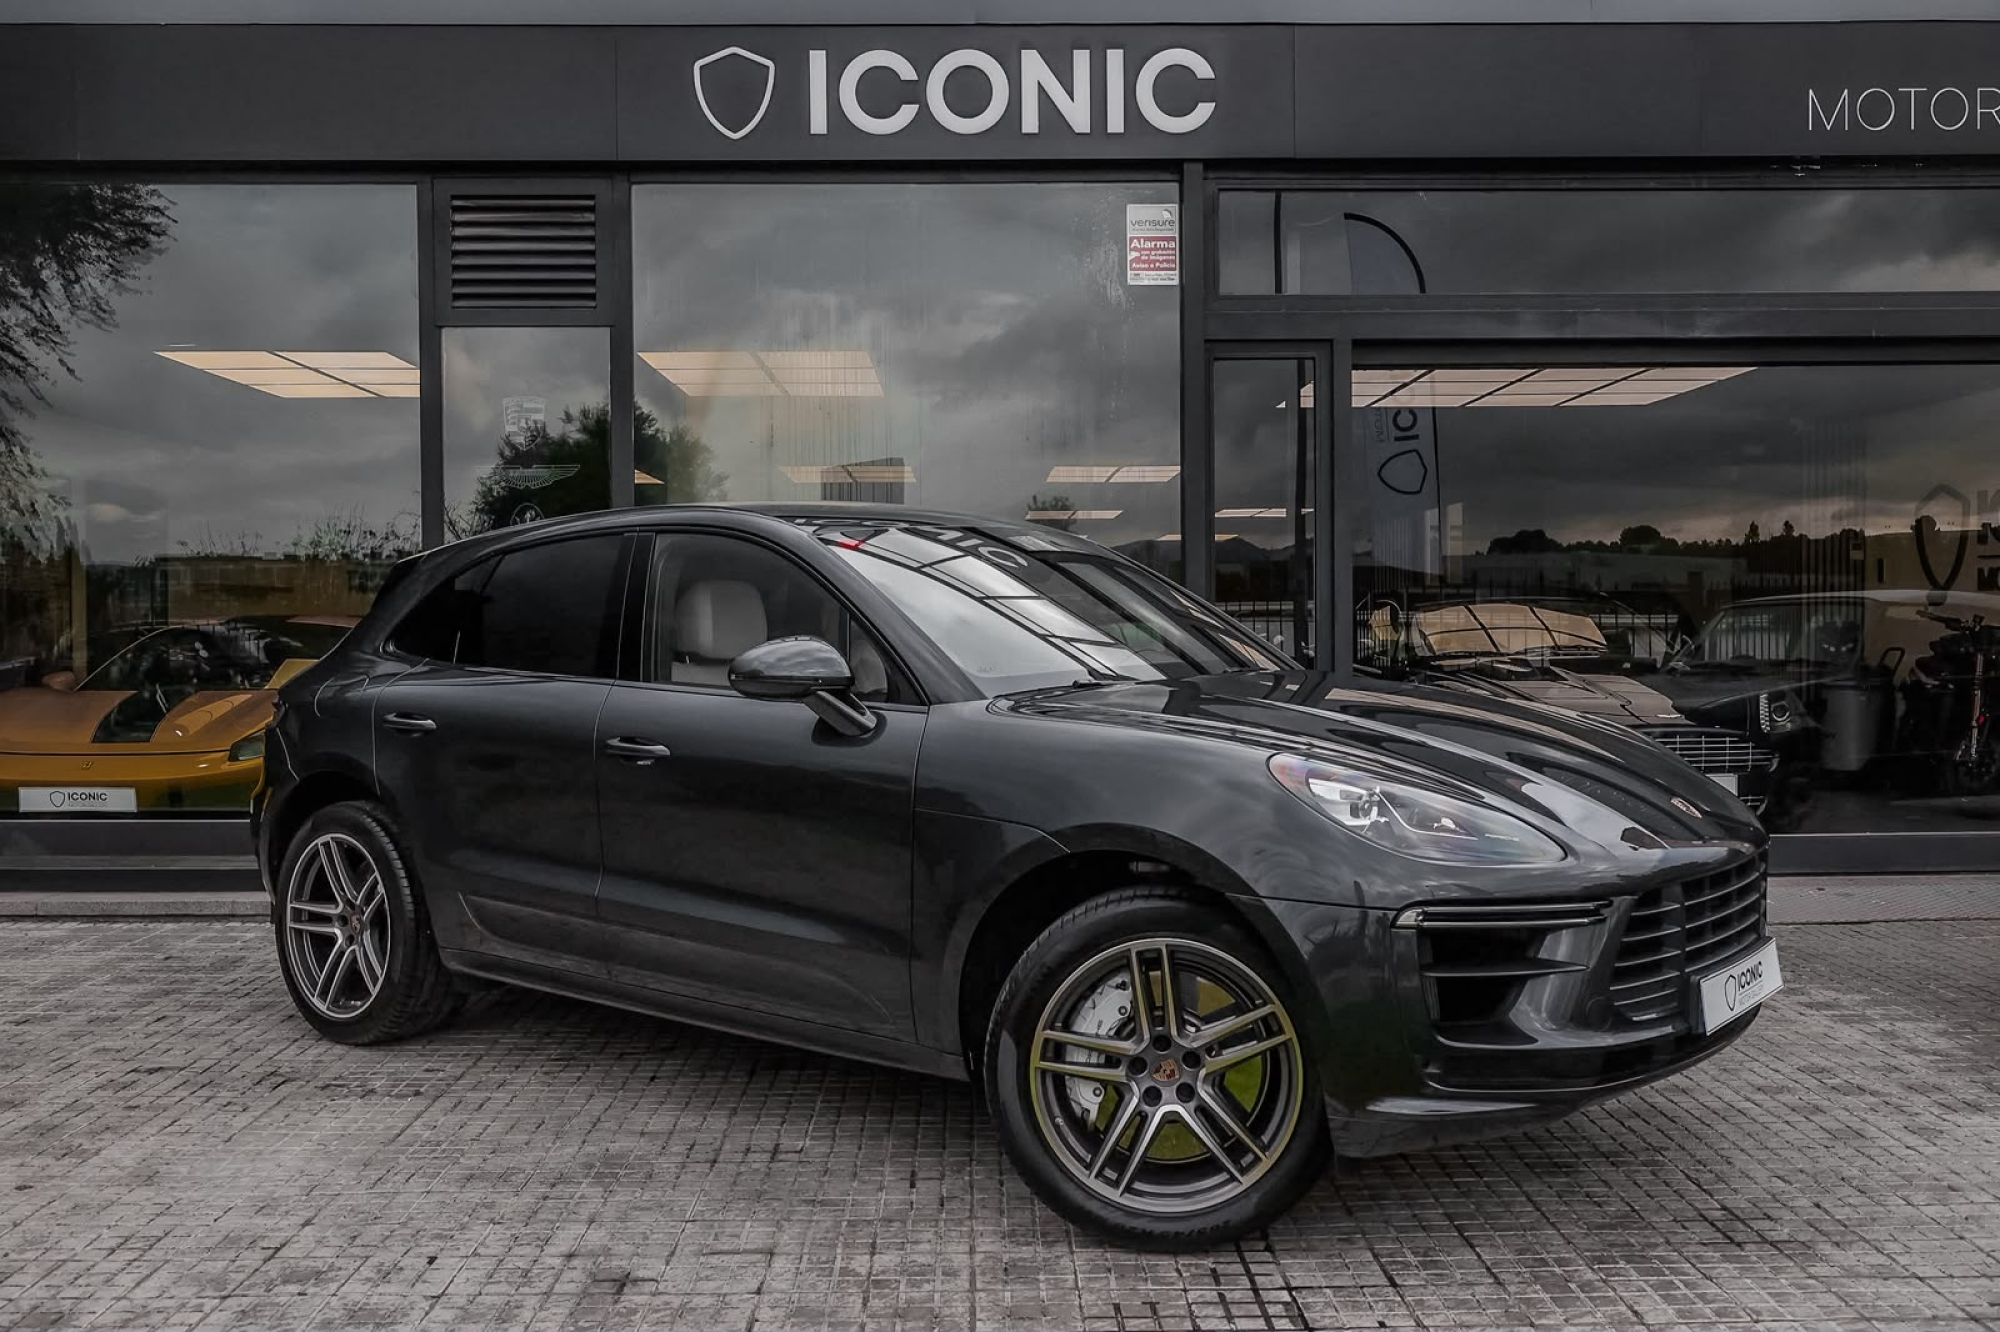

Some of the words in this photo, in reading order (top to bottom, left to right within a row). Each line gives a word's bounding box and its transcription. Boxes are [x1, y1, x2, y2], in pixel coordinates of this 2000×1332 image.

[809, 48, 1217, 135] ICONIC
[1130, 239, 1175, 248] Alarma
[68, 792, 108, 801] ICONIC
[1738, 961, 1763, 991] ICONIC
